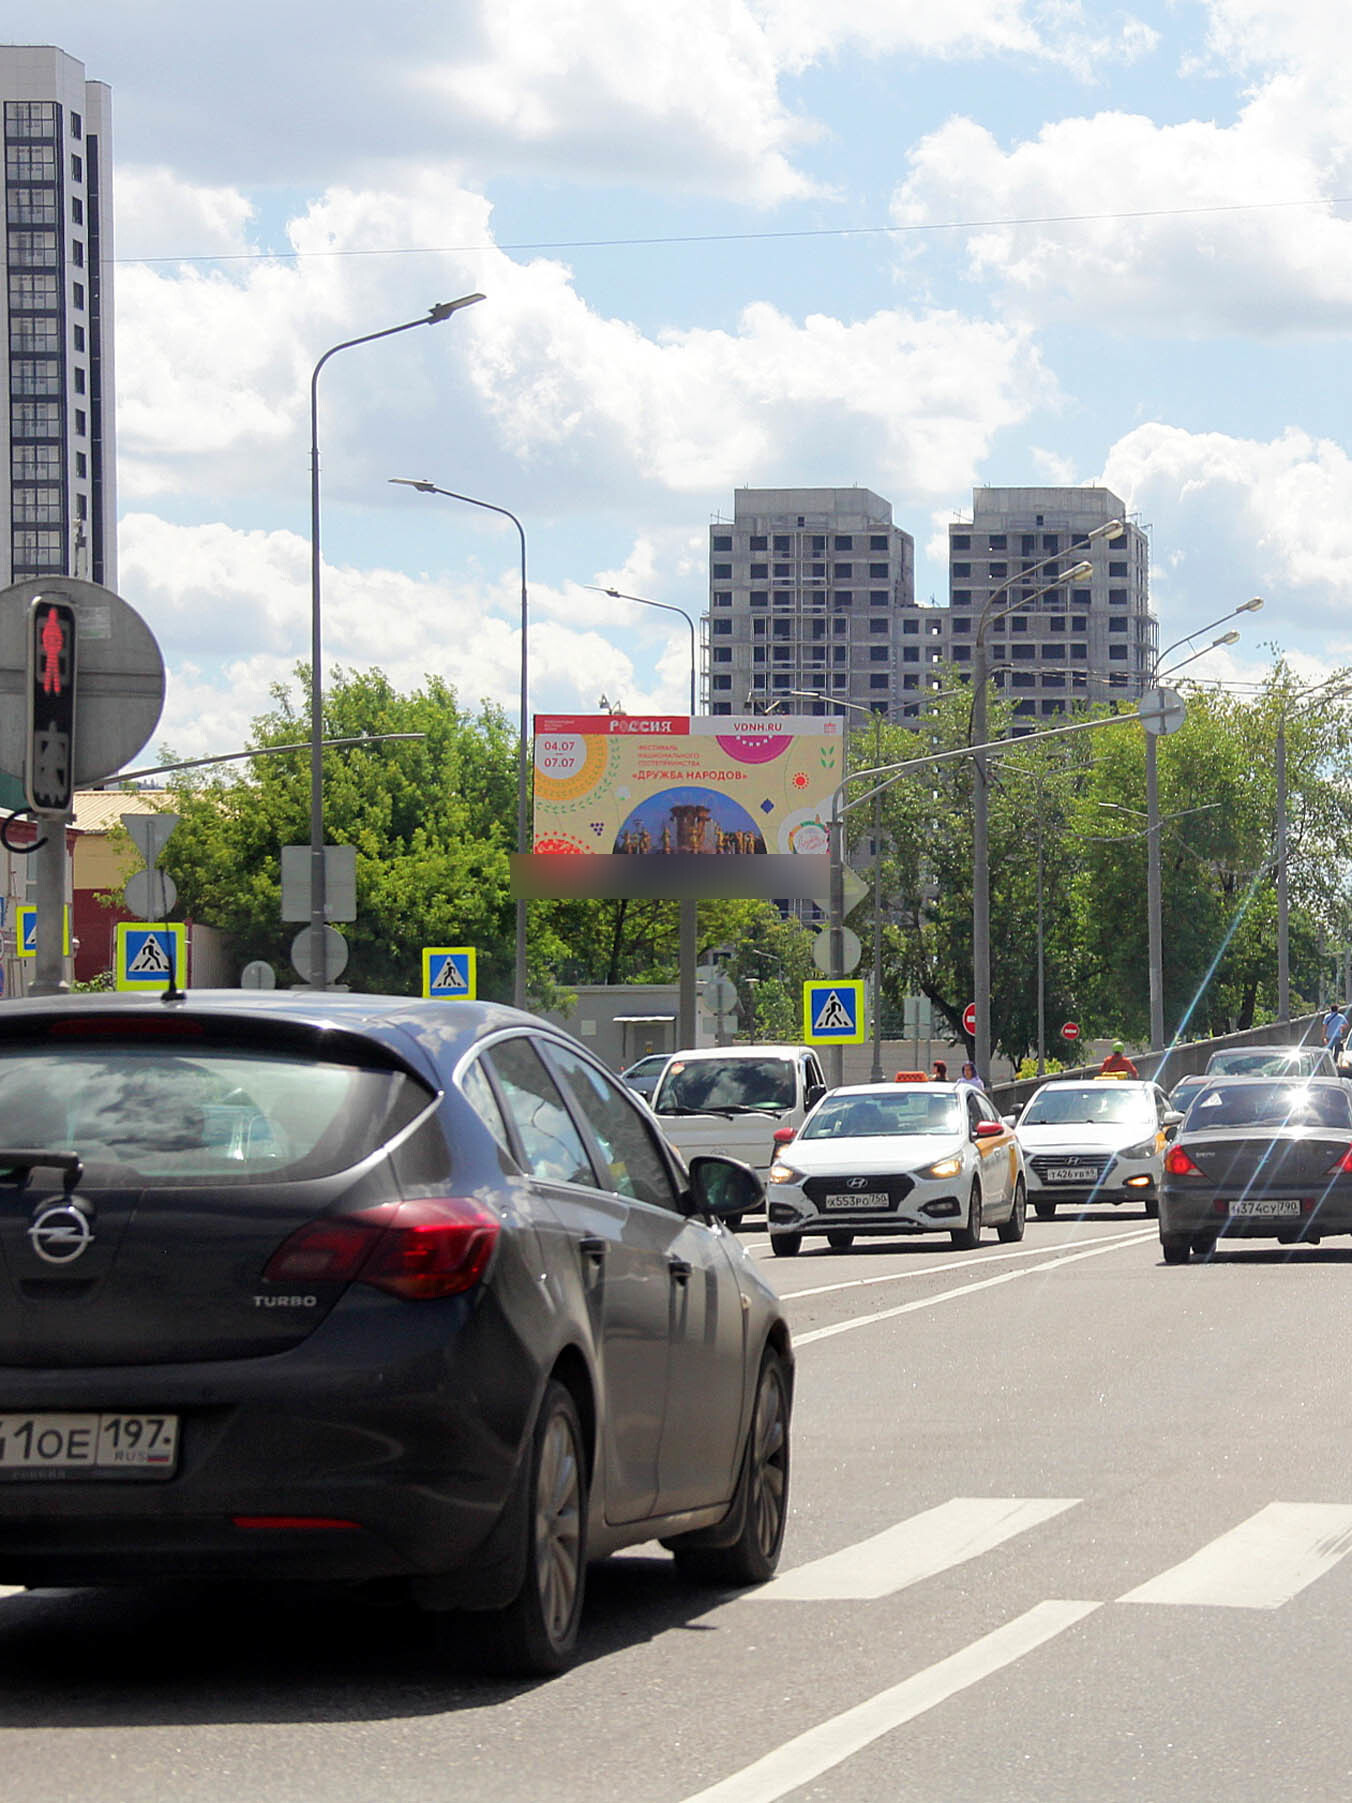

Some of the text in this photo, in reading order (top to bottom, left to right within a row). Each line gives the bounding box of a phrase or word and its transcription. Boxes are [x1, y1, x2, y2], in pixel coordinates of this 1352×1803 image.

[609, 720, 672, 732] РОССИЯ
[734, 722, 782, 732] VDNH.RU
[544, 741, 575, 751] 04.07
[544, 757, 575, 768] 07.07
[632, 770, 748, 780] «ДРУЖБА НАРОДОВ»
[254, 1295, 317, 1307] TURBO
[104, 1418, 165, 1449] 197
